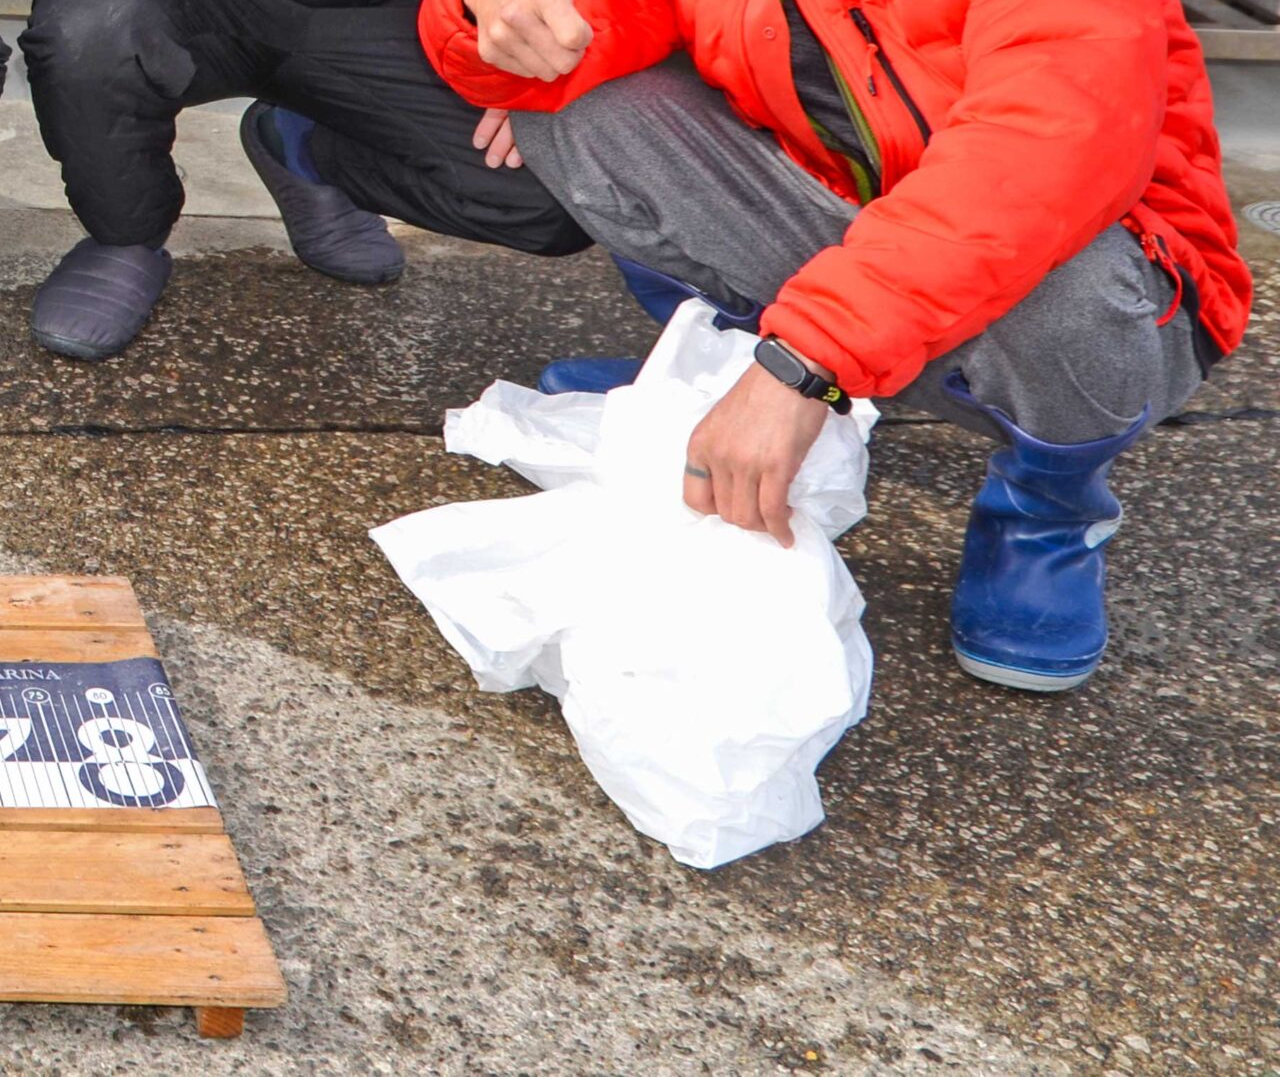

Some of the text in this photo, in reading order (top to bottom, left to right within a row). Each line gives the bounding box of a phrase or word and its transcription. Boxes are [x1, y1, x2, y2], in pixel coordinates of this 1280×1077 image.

[28, 691, 44, 700] 75
[93, 692, 107, 700] 80
[155, 686, 171, 696] 85
[77, 717, 185, 807] 8
